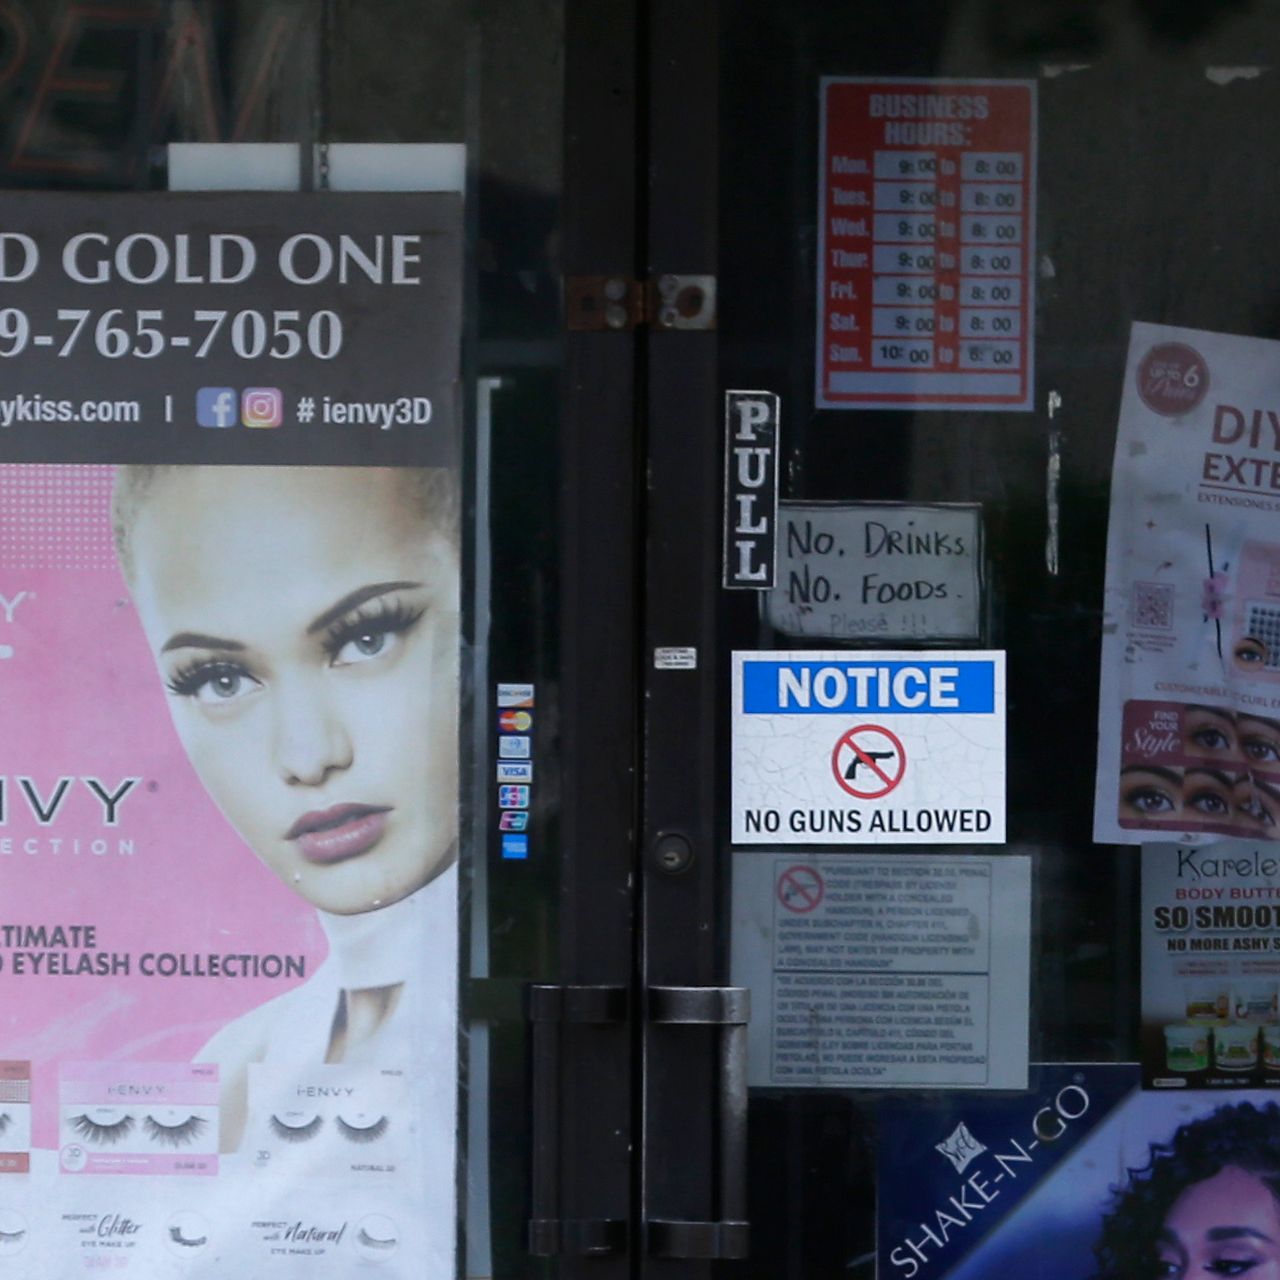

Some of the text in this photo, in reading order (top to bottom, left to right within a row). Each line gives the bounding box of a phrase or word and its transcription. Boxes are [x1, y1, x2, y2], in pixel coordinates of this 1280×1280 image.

[868, 93, 989, 119] BUSINESS
[884, 122, 972, 147] HOURS:
[62, 231, 257, 286] GOLD
[278, 233, 422, 287] ONE
[322, 395, 433, 428] ienvy3D
[734, 399, 771, 581] PULL
[776, 666, 960, 709] NOTICE
[1124, 727, 1182, 757] Style
[502, 767, 528, 776] VISA
[744, 809, 993, 833] NO GUNS ALLOWED
[1175, 887, 1225, 900] BODY
[1154, 905, 1189, 930] SO
[1167, 938, 1186, 952] NO
[1189, 937, 1229, 952] MORE
[1231, 936, 1270, 951] ASHY
[12, 953, 131, 977] EYELASH
[138, 952, 307, 979] COLLECTION
[890, 1079, 1093, 1280] SHAKE-N-GO
